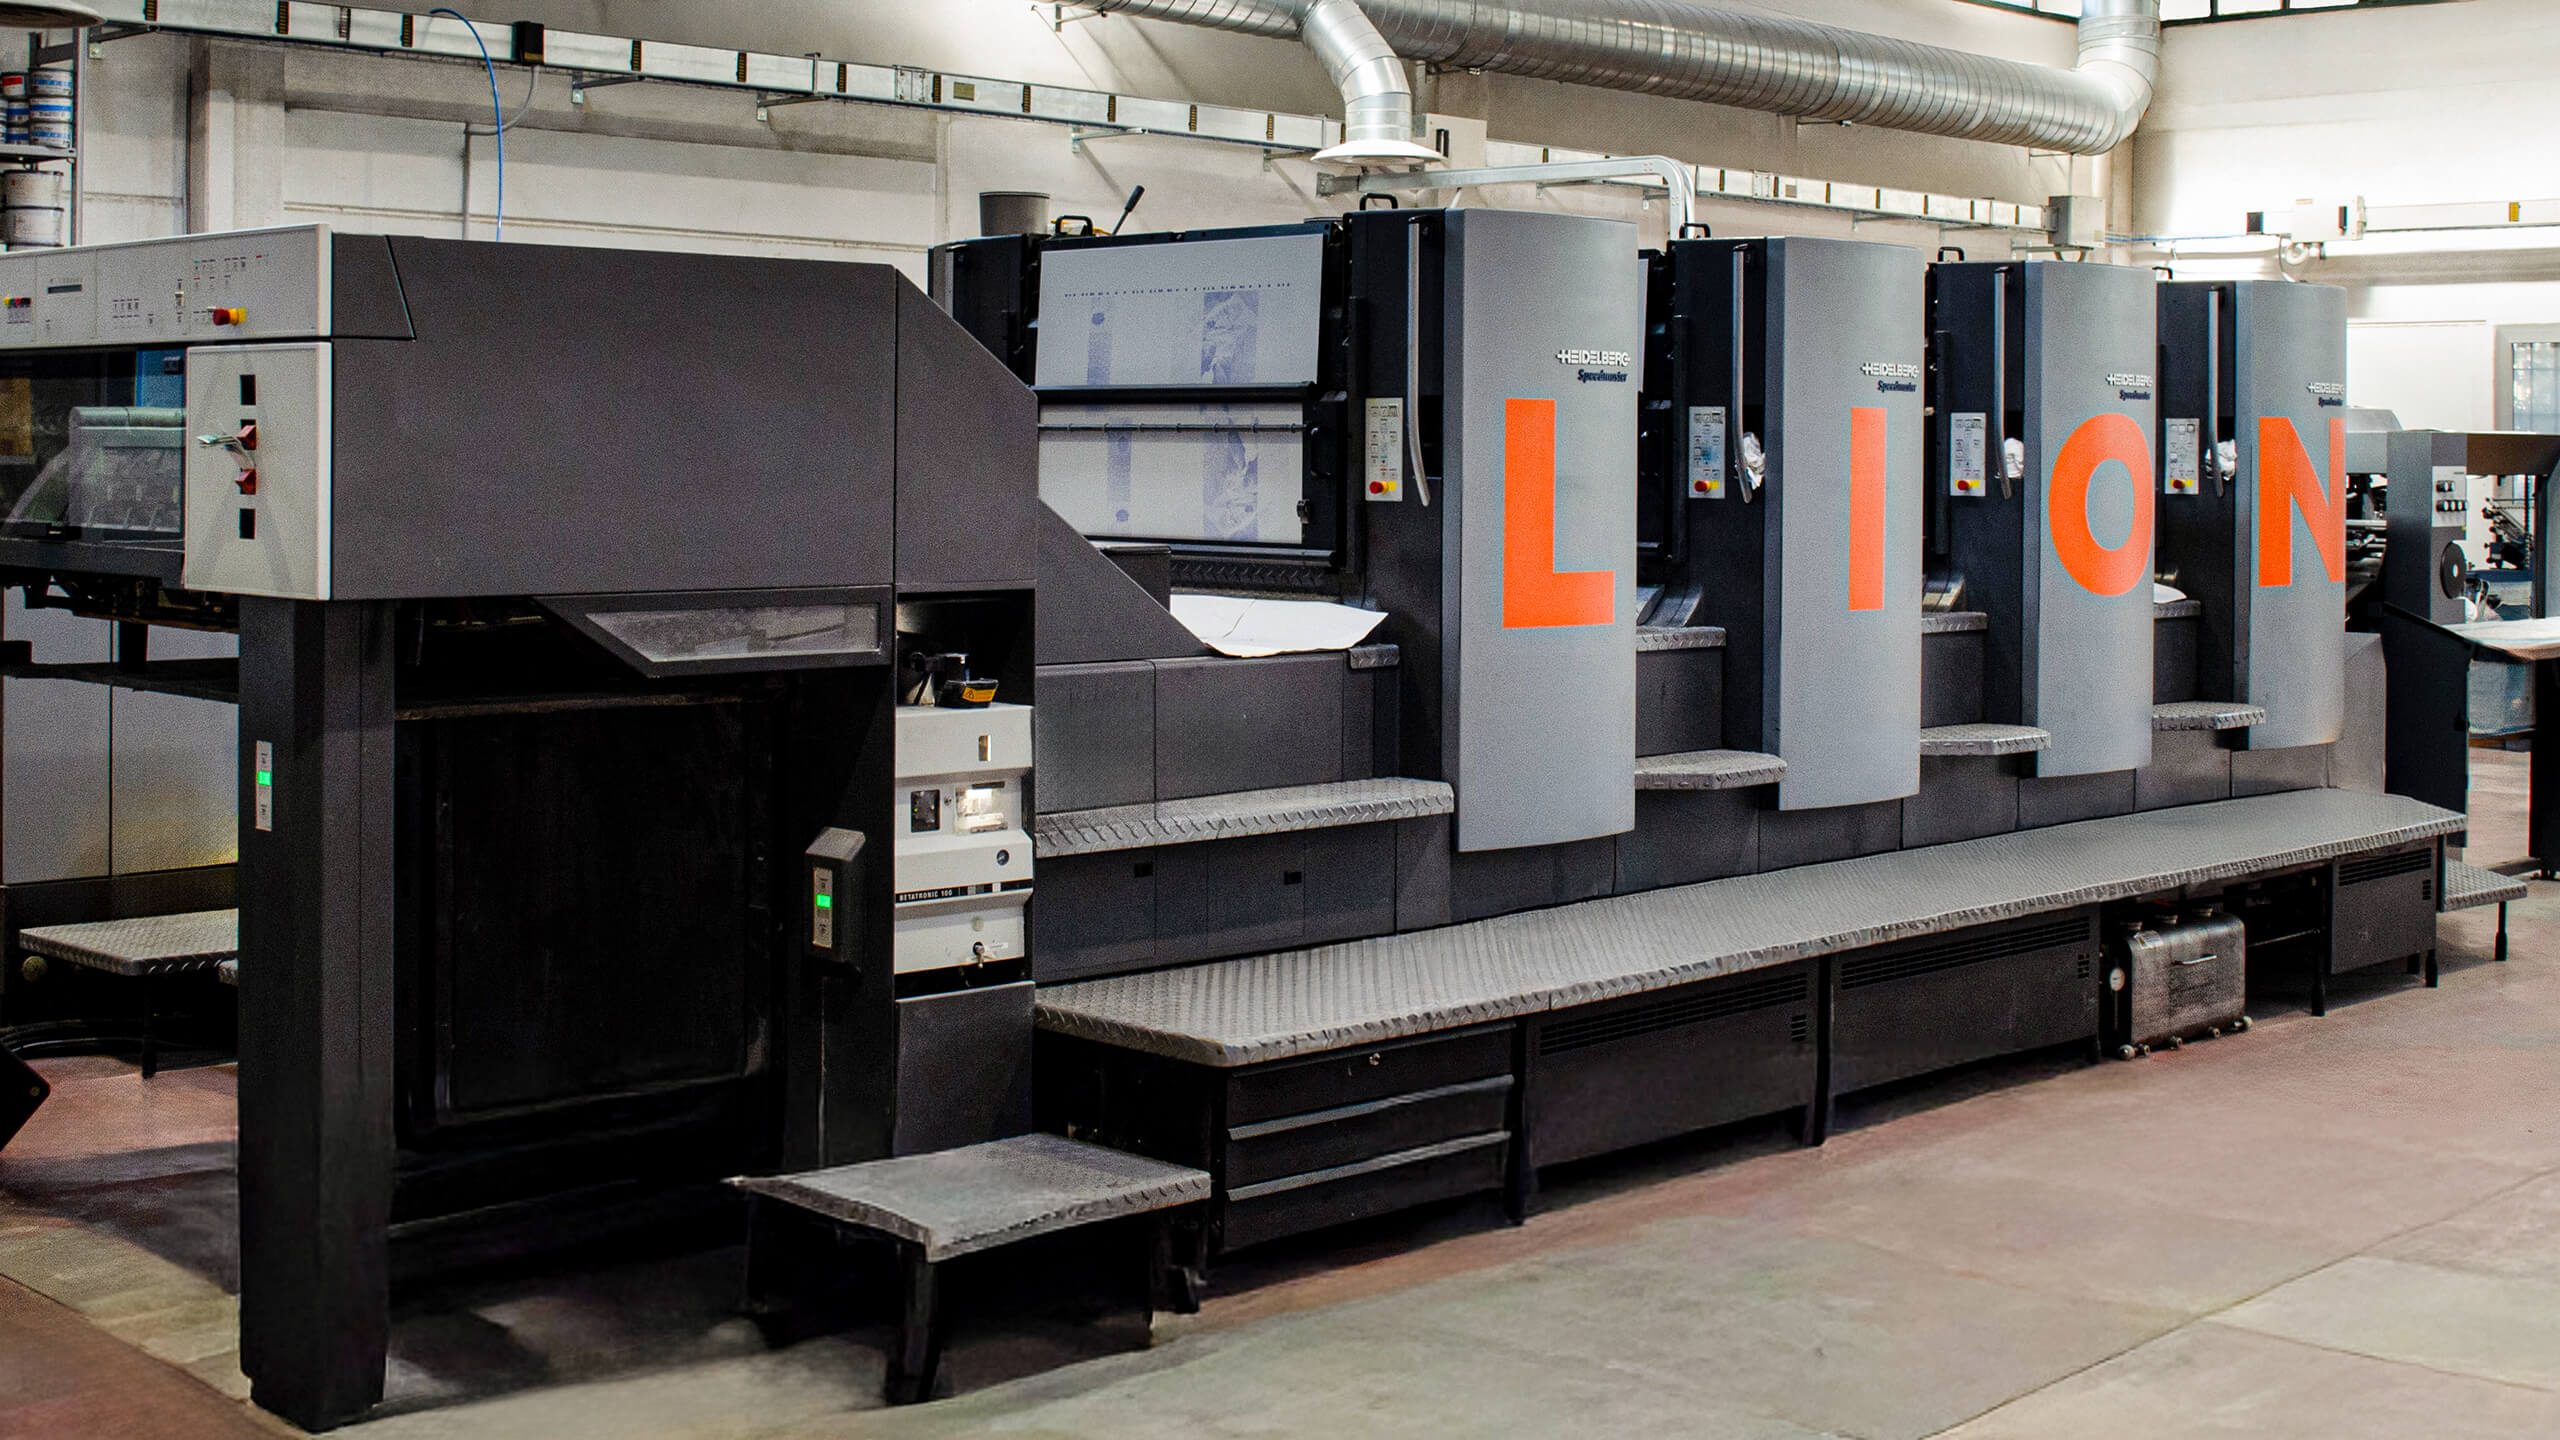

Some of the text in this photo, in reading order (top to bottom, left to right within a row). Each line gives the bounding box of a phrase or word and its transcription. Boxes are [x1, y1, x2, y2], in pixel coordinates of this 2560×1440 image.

[1557, 350, 1631, 366] HEIDELBERG
[1862, 363, 1919, 378] HEIDELBERG
[941, 889, 953, 897] 100
